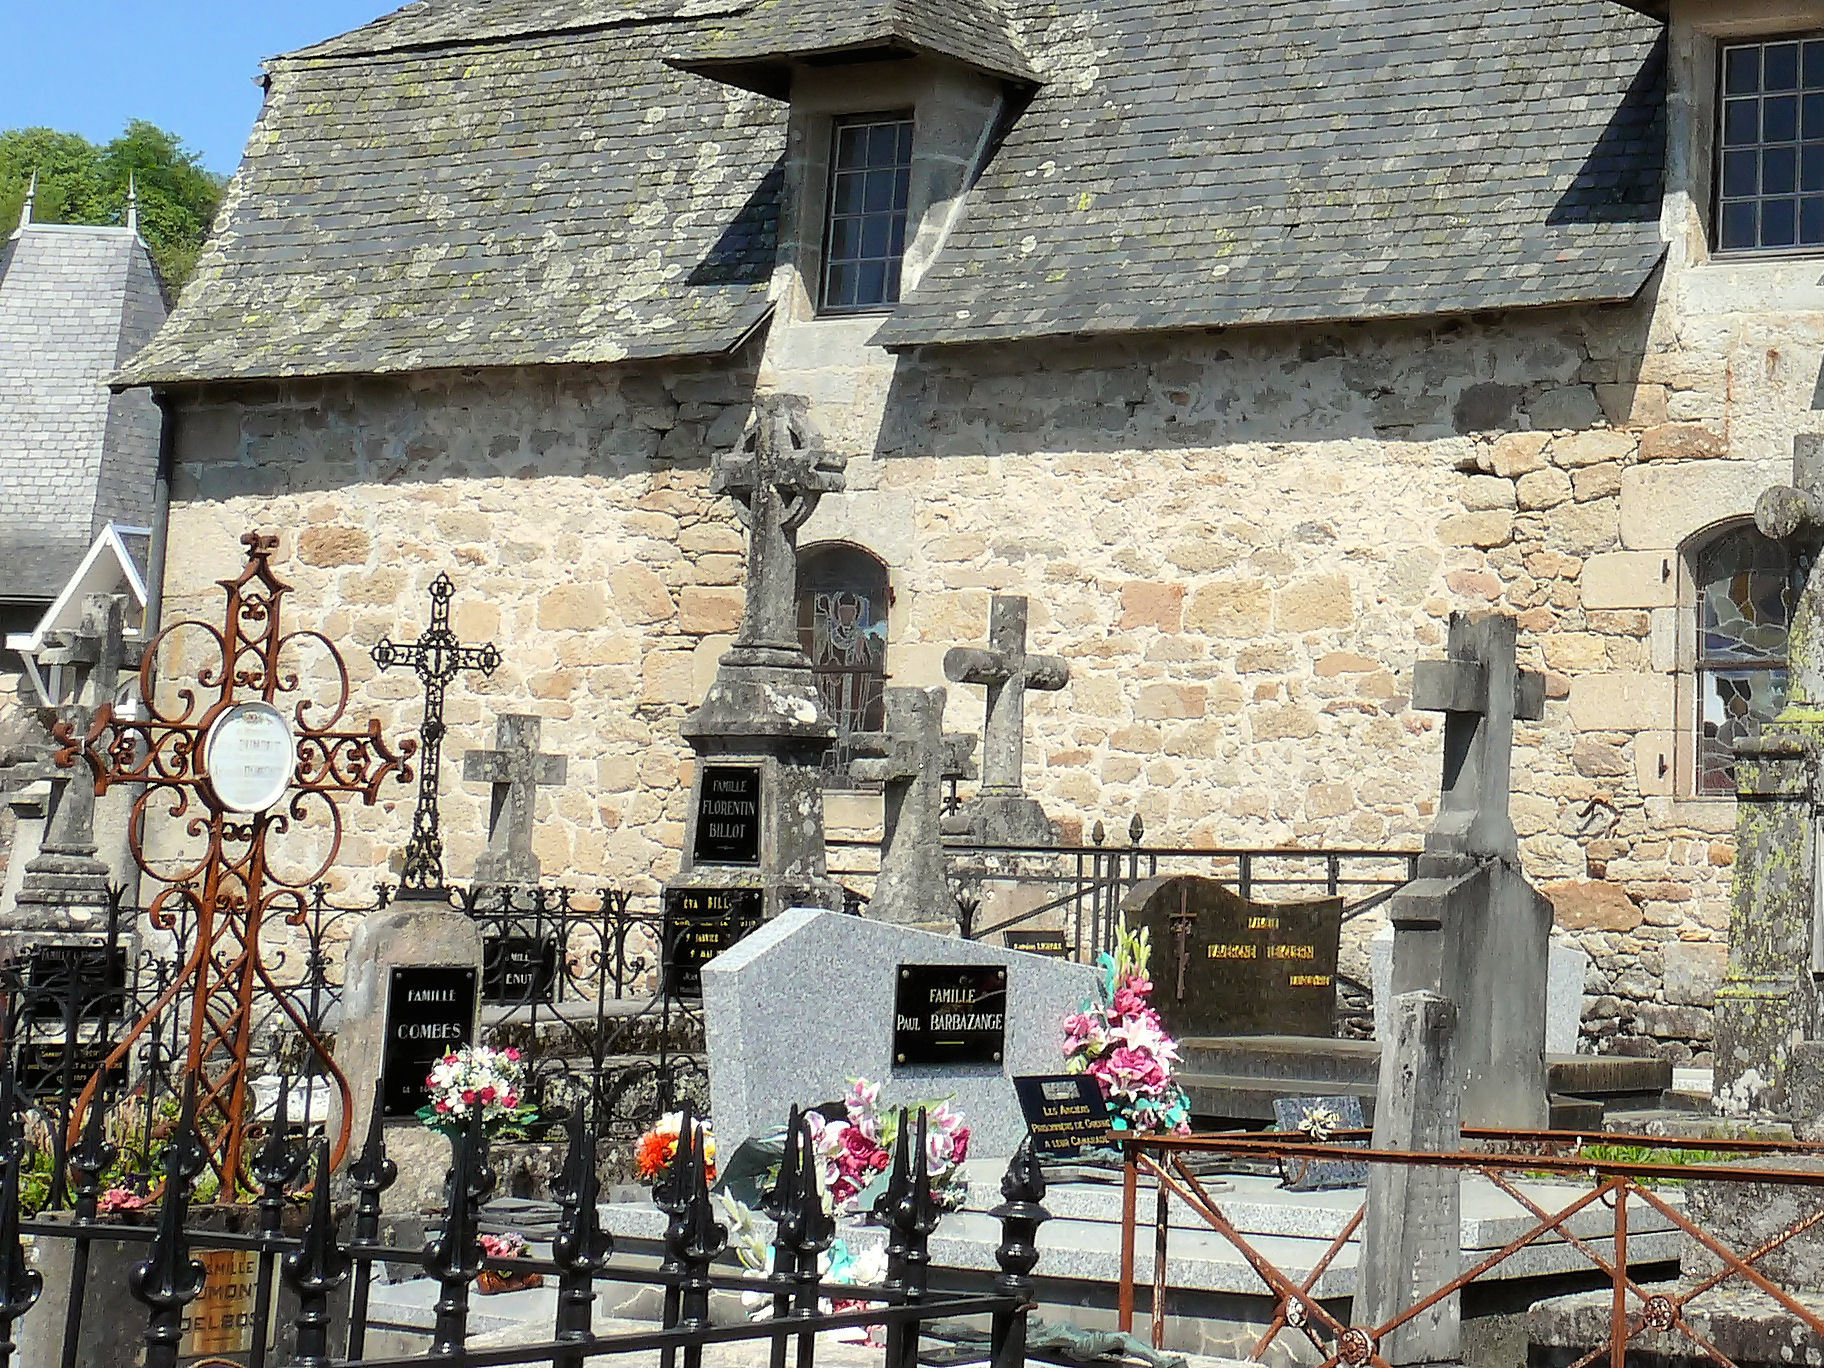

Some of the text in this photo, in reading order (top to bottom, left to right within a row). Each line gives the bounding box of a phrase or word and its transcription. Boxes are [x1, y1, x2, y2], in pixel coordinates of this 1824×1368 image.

[713, 780, 748, 793] FAMILLE
[702, 799, 755, 816] FLORENTIN
[709, 822, 746, 839] BILLOT
[707, 896, 730, 910] BILL
[408, 989, 456, 1002] FAMILLE
[929, 988, 976, 1003] FAMILLE
[930, 1013, 1003, 1031] BARBAZANGE
[397, 1023, 461, 1040] COMBES
[205, 1261, 255, 1275] AMILLE
[196, 1282, 259, 1300] UMON
